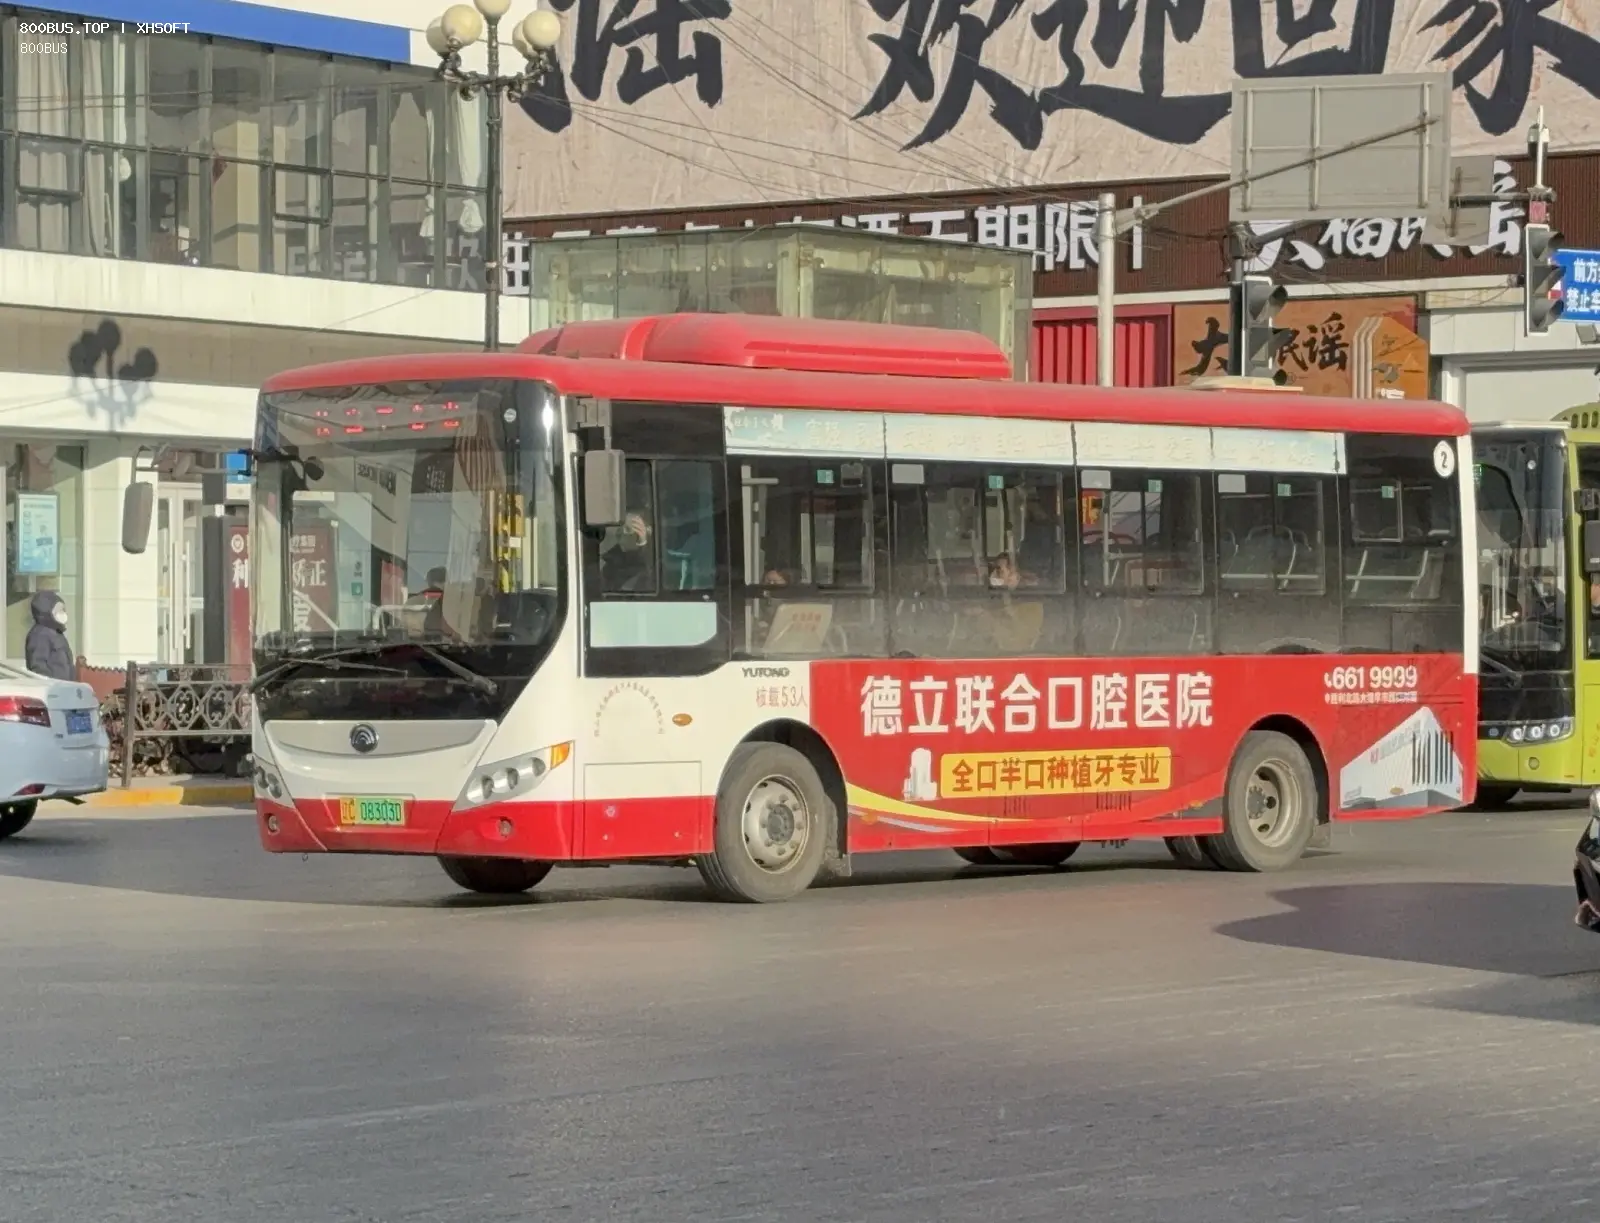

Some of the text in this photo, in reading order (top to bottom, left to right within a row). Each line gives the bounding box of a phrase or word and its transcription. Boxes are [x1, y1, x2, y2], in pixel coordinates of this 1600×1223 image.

[741, 667, 789, 677] YUTONG
[1369, 665, 1418, 688] 9999
[860, 671, 1213, 737] 德立联合口腔医院
[951, 752, 1160, 793] 全口半口种植牙专业
